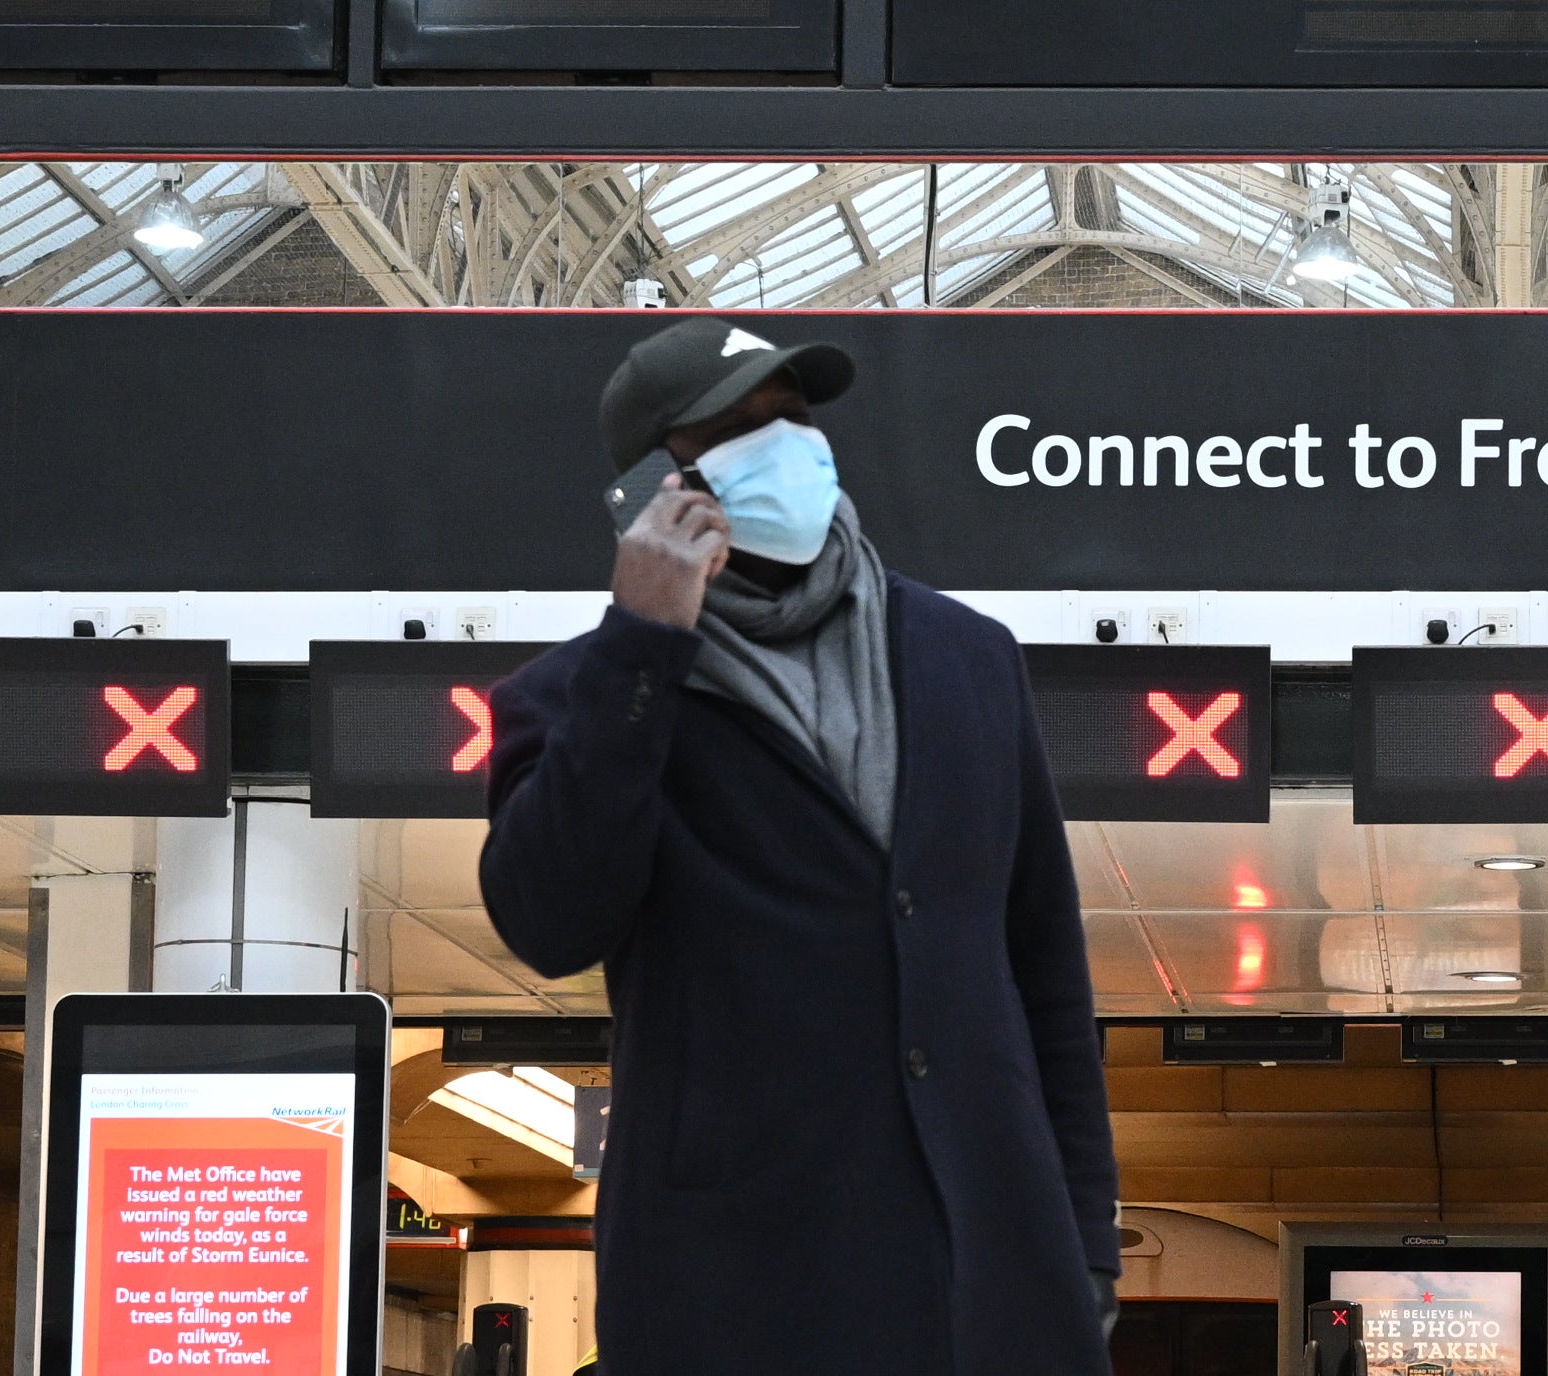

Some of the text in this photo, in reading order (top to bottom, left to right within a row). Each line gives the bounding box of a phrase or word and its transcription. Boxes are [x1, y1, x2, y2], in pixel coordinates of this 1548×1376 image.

[975, 413, 1325, 488] Connect
[1348, 423, 1437, 489] to
[129, 1165, 302, 1183] The Met Office have
[127, 1185, 303, 1203] issued a red weather
[120, 1205, 308, 1227] warning for gale force
[140, 1226, 287, 1247] winds today, as a
[1404, 1236, 1446, 1246] JCDecaux
[116, 1246, 309, 1263] result of Storm Eunice.
[115, 1286, 309, 1308] Due a large number of
[130, 1306, 292, 1328] trees falling on the
[1379, 1309, 1473, 1320] WE BELIEVE IN
[177, 1327, 243, 1348] railway,
[1364, 1319, 1501, 1338] HE PHOTO
[148, 1348, 271, 1365] Do Not Travel.
[1365, 1341, 1506, 1360] ESS TAKEN.
